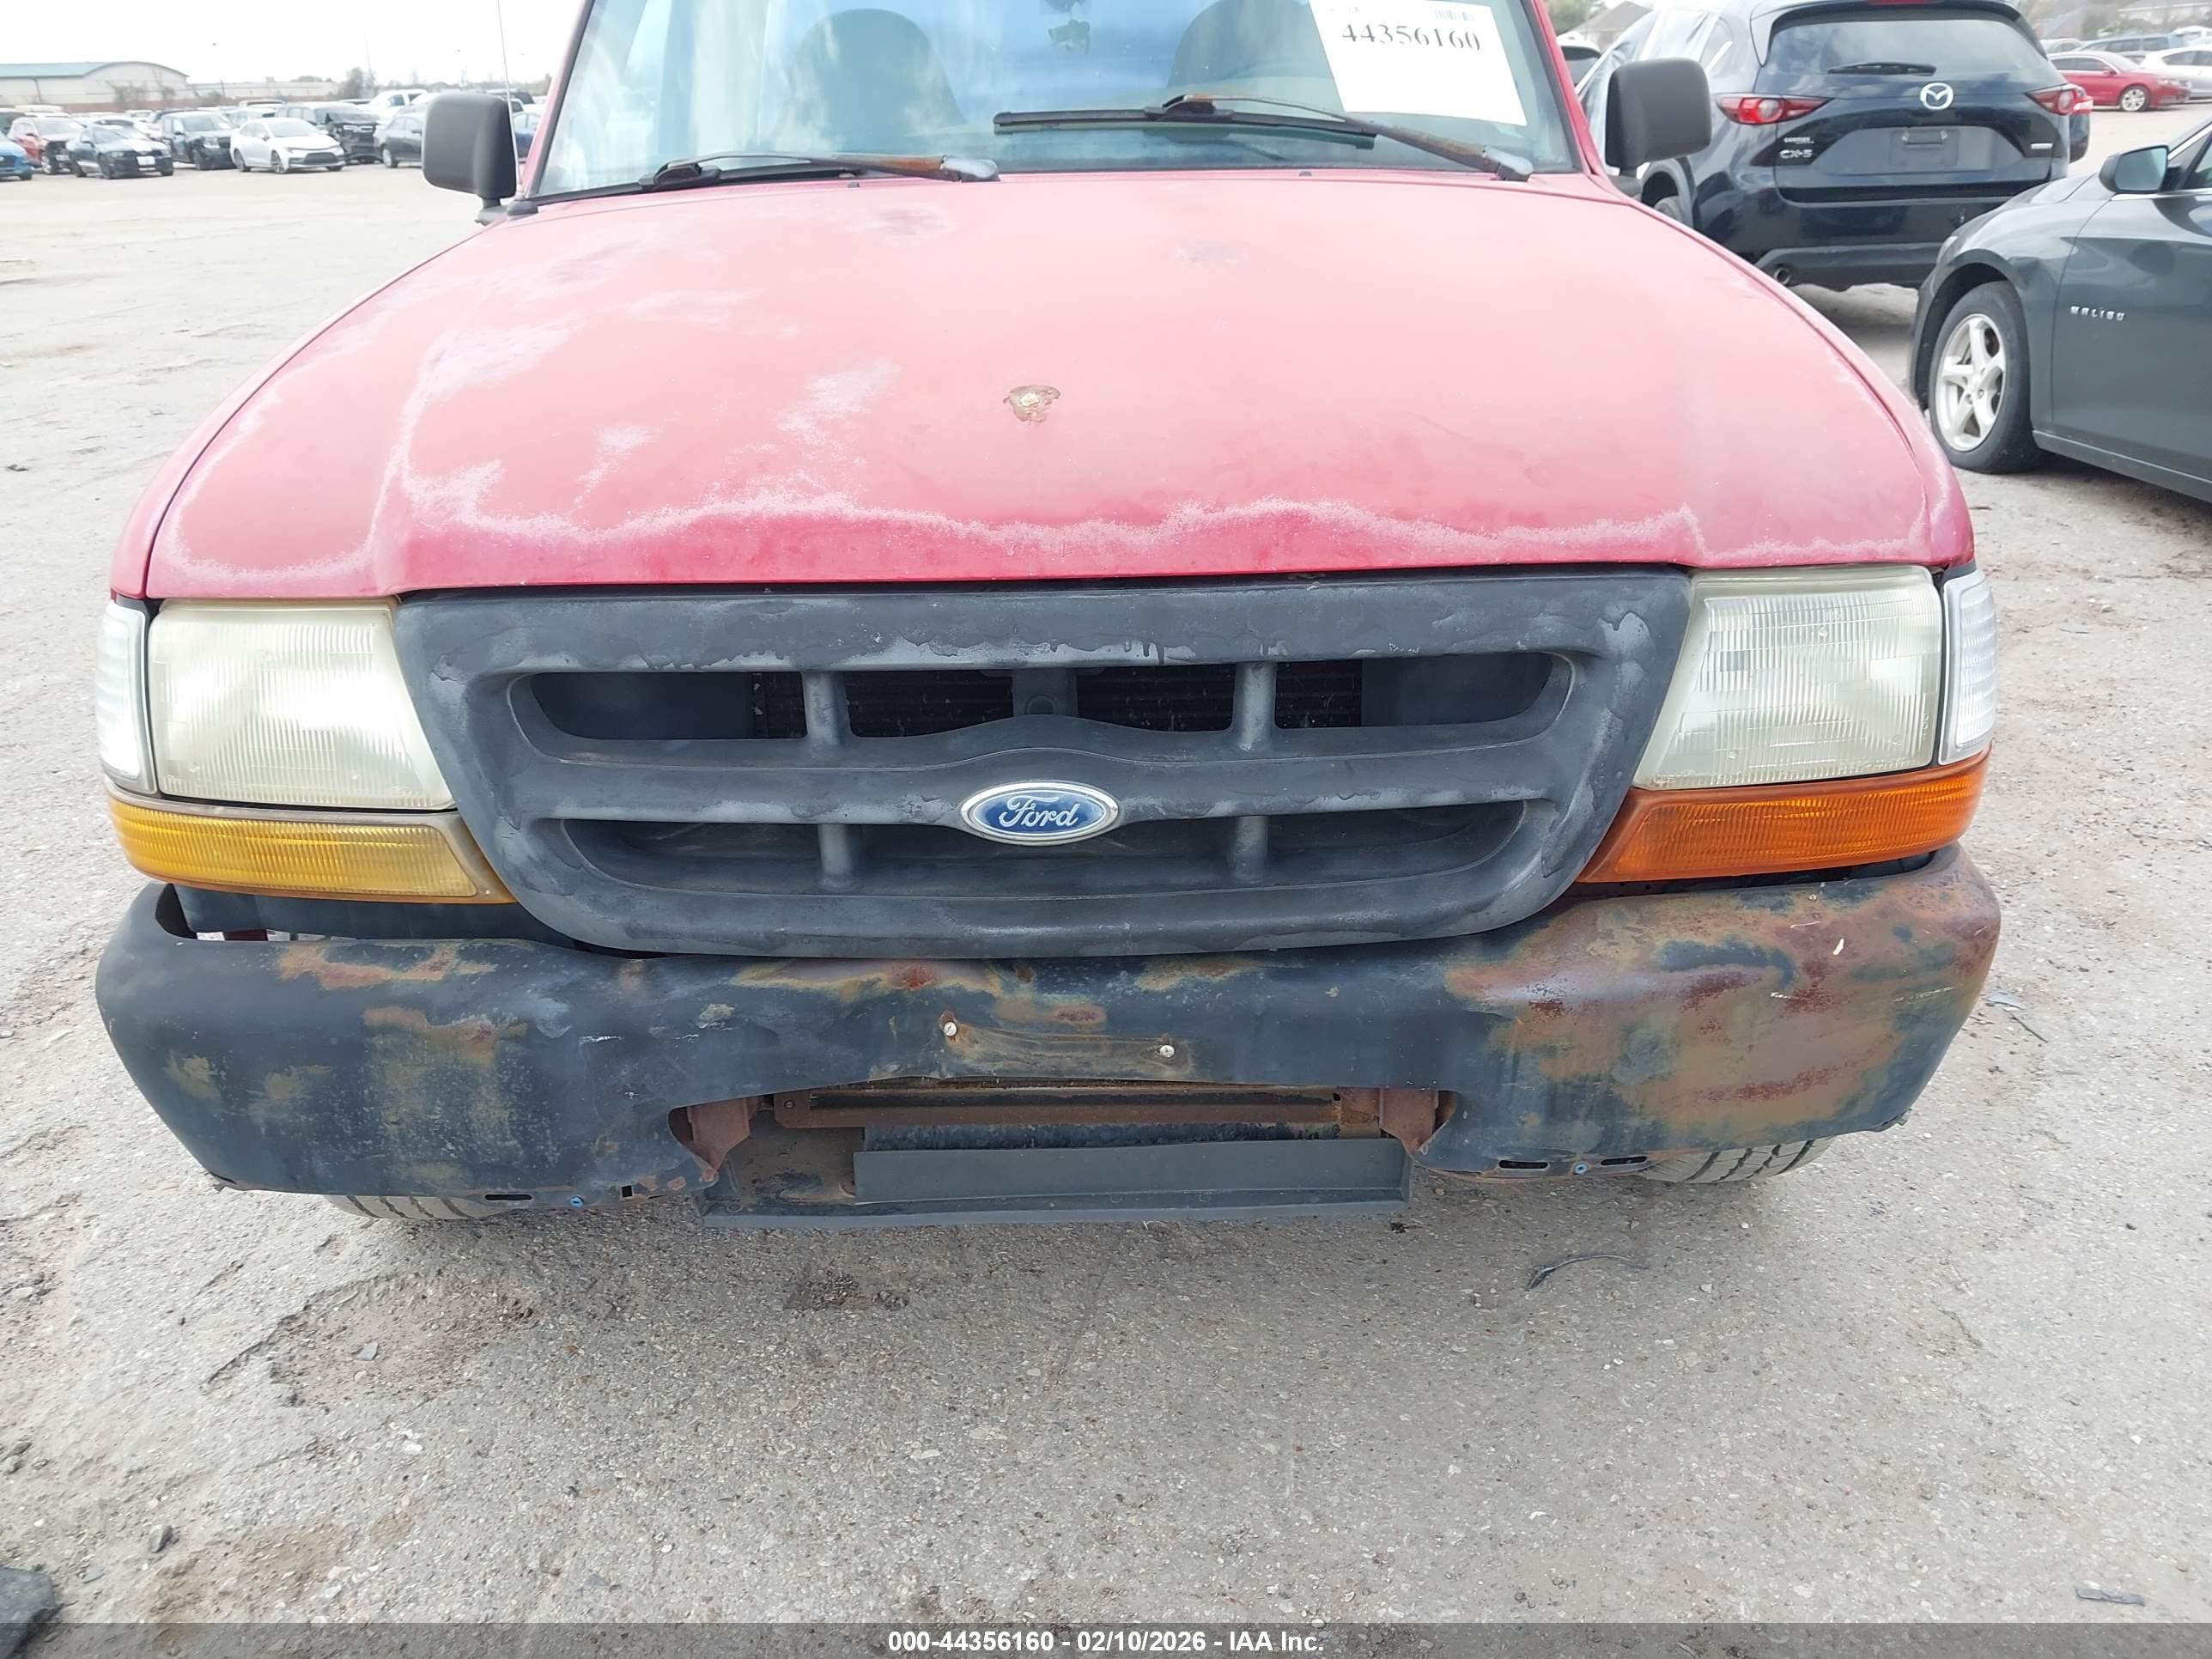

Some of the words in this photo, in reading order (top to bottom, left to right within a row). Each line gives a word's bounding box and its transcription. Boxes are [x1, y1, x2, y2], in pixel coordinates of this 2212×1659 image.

[1341, 23, 1481, 51] 44356160
[1779, 149, 1814, 159] CX-5
[999, 795, 1080, 828] Ford
